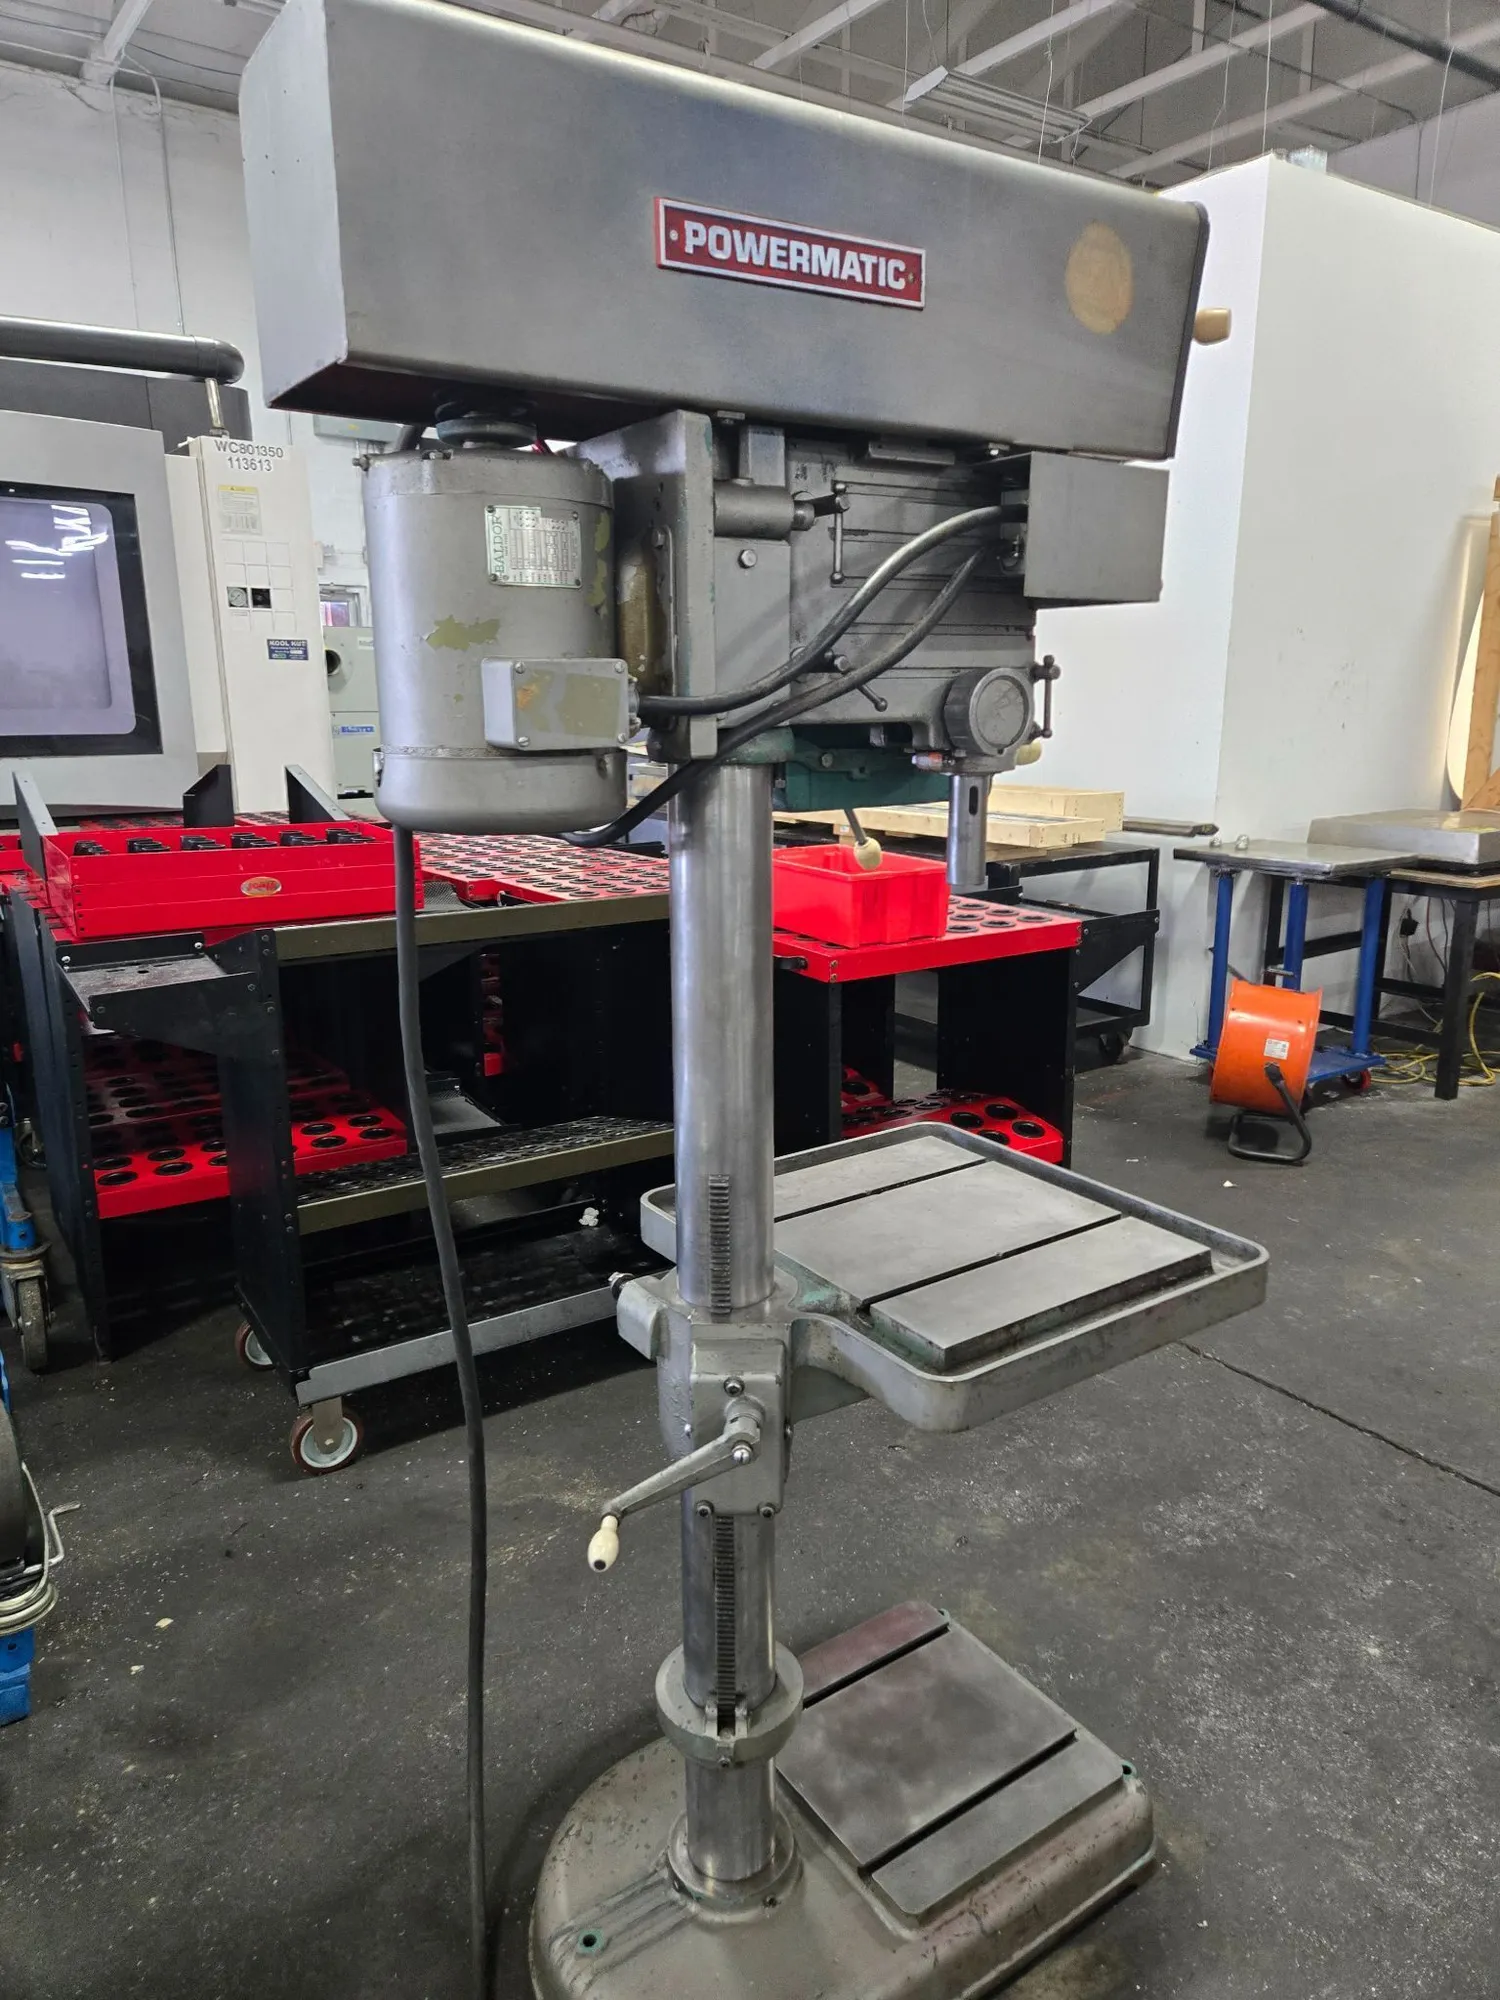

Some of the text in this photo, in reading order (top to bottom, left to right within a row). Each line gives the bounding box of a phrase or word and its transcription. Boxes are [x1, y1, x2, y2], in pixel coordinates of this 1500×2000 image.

[684, 220, 906, 290] POWERMATIC
[214, 439, 284, 458] WC801350
[228, 456, 272, 472] 113613
[492, 515, 505, 573] BALDOR
